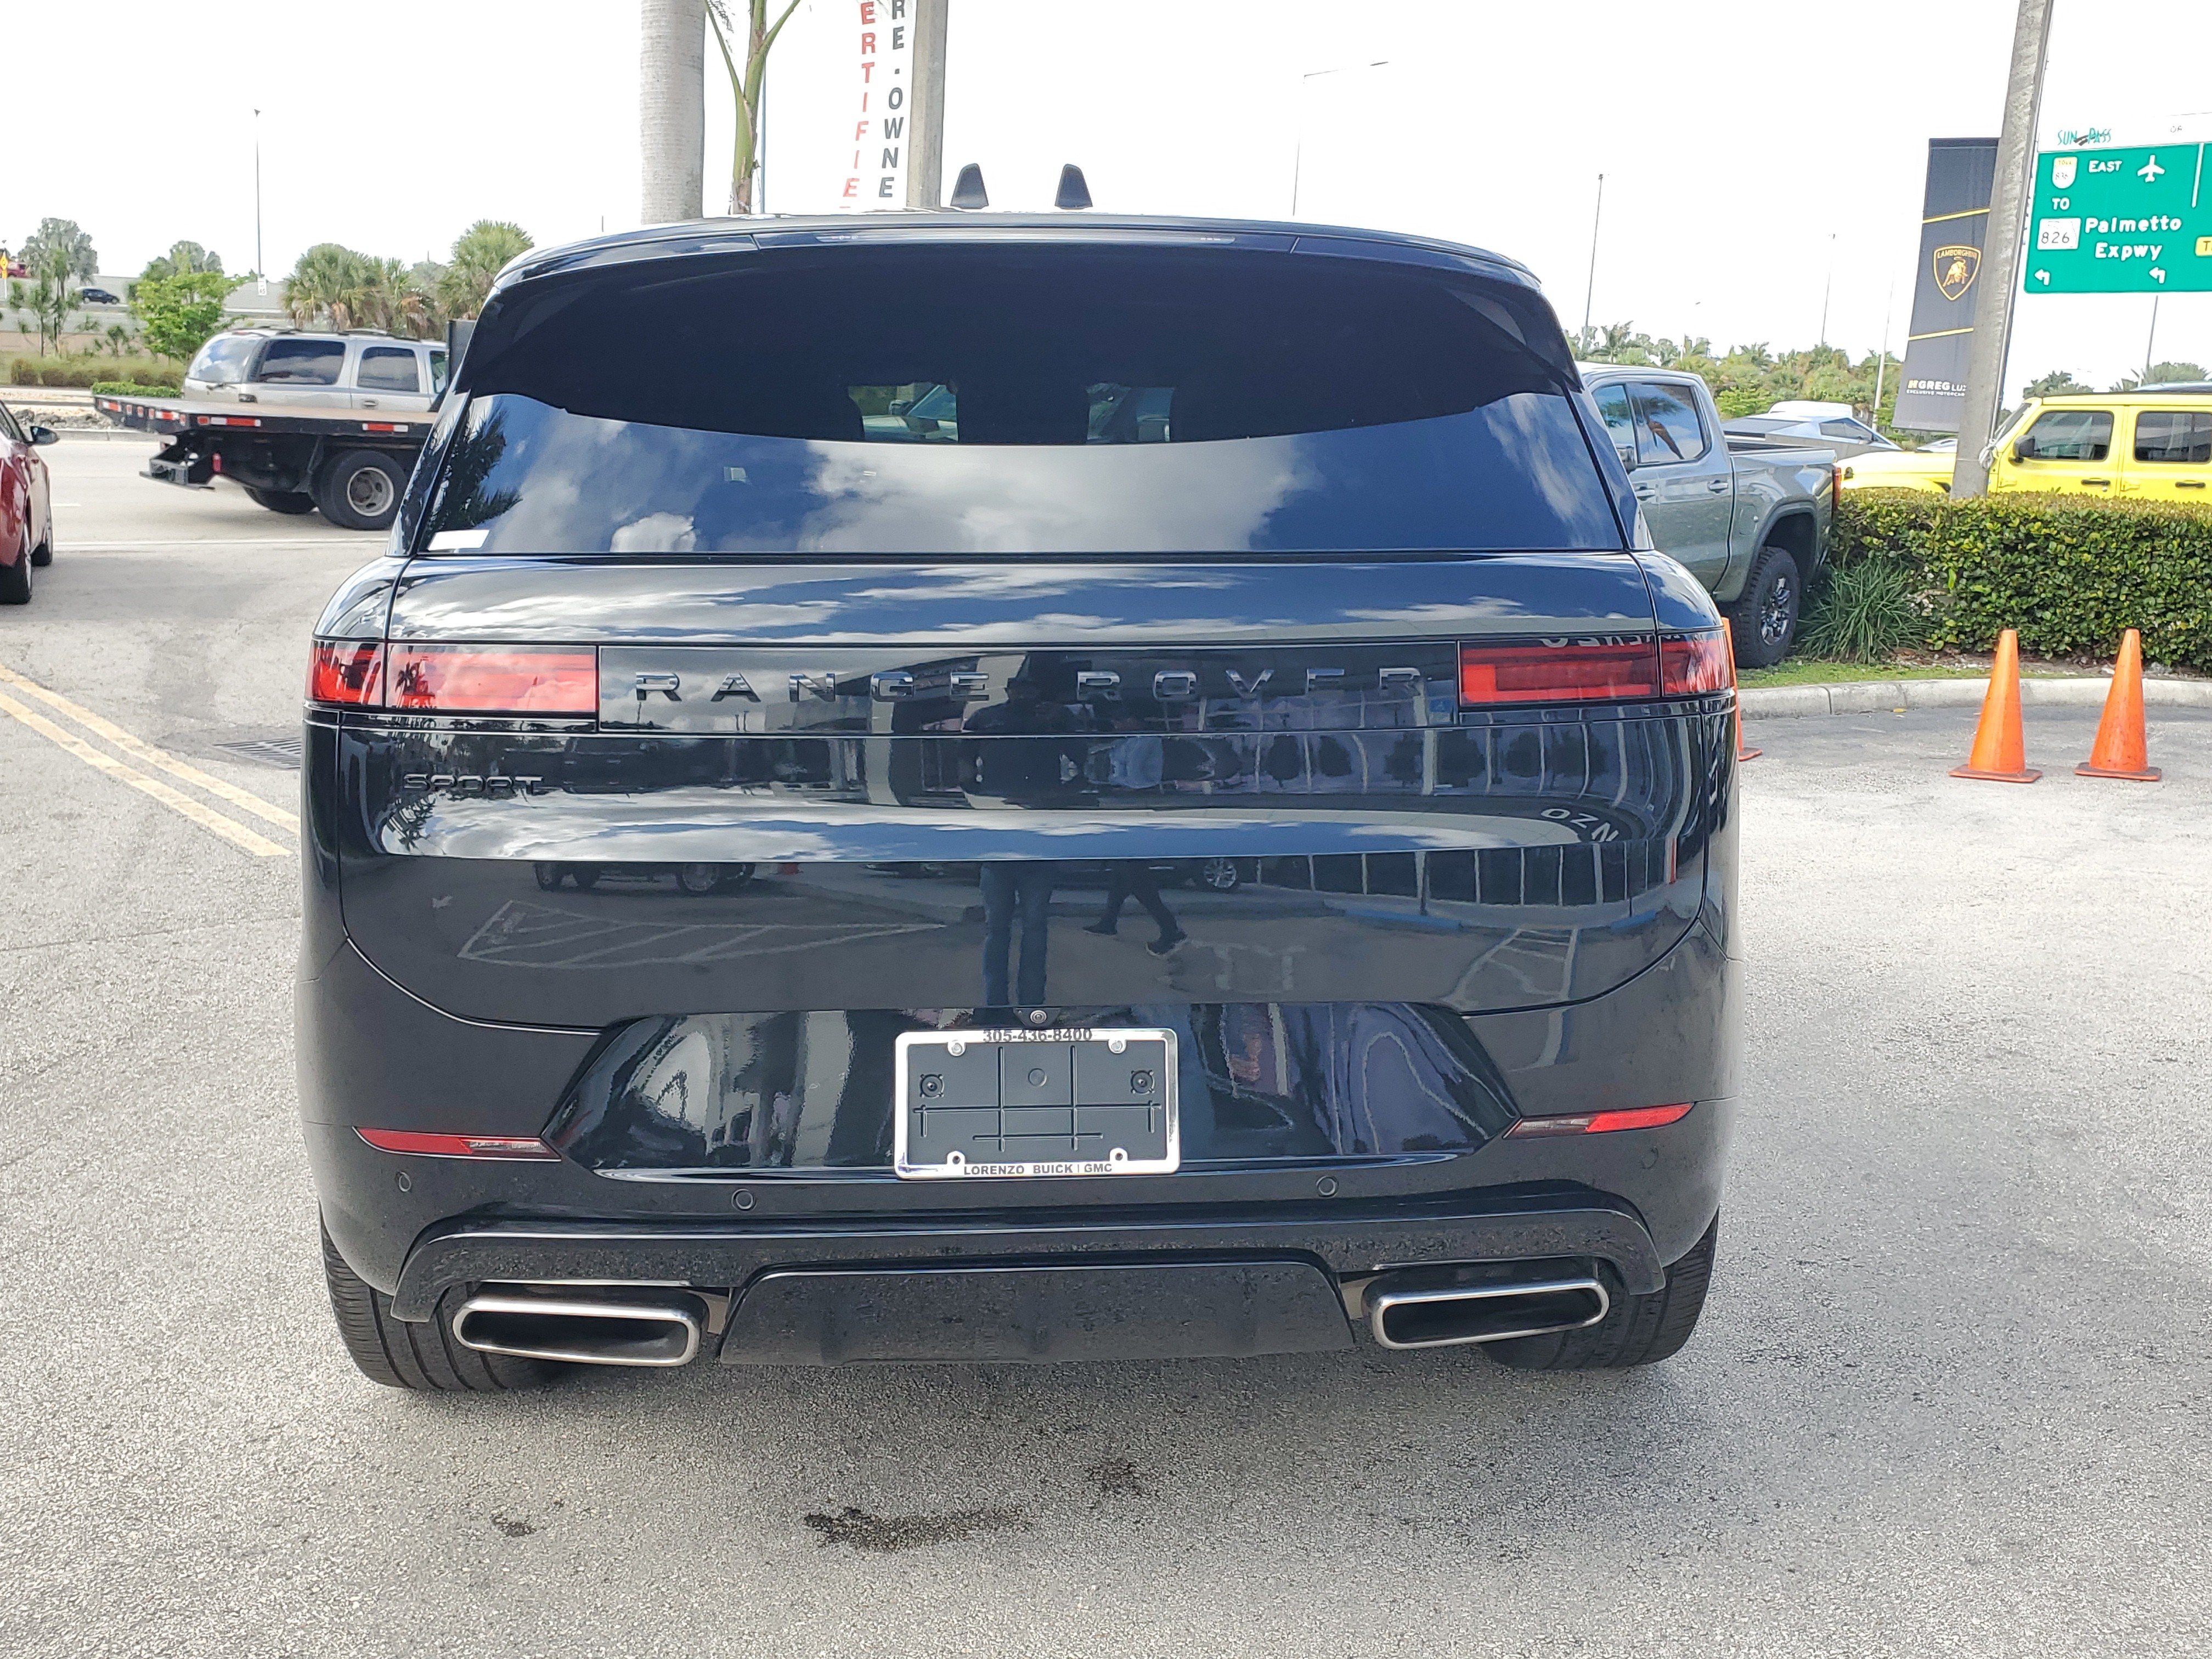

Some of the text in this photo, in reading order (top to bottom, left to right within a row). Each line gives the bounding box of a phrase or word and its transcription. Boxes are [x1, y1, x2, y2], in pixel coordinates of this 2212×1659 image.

[2089, 160, 2123, 173] EAST
[2052, 198, 2070, 210] TO
[2085, 215, 2182, 233] Palmetto
[2041, 232, 2070, 244] 826
[2095, 241, 2163, 261] Expwy
[635, 667, 1422, 703] RANGE ROVER
[403, 773, 545, 797] SPORT
[983, 1028, 1093, 1042] 305-436-8400
[963, 1163, 1113, 1175] LORENZO BUICK GMC
